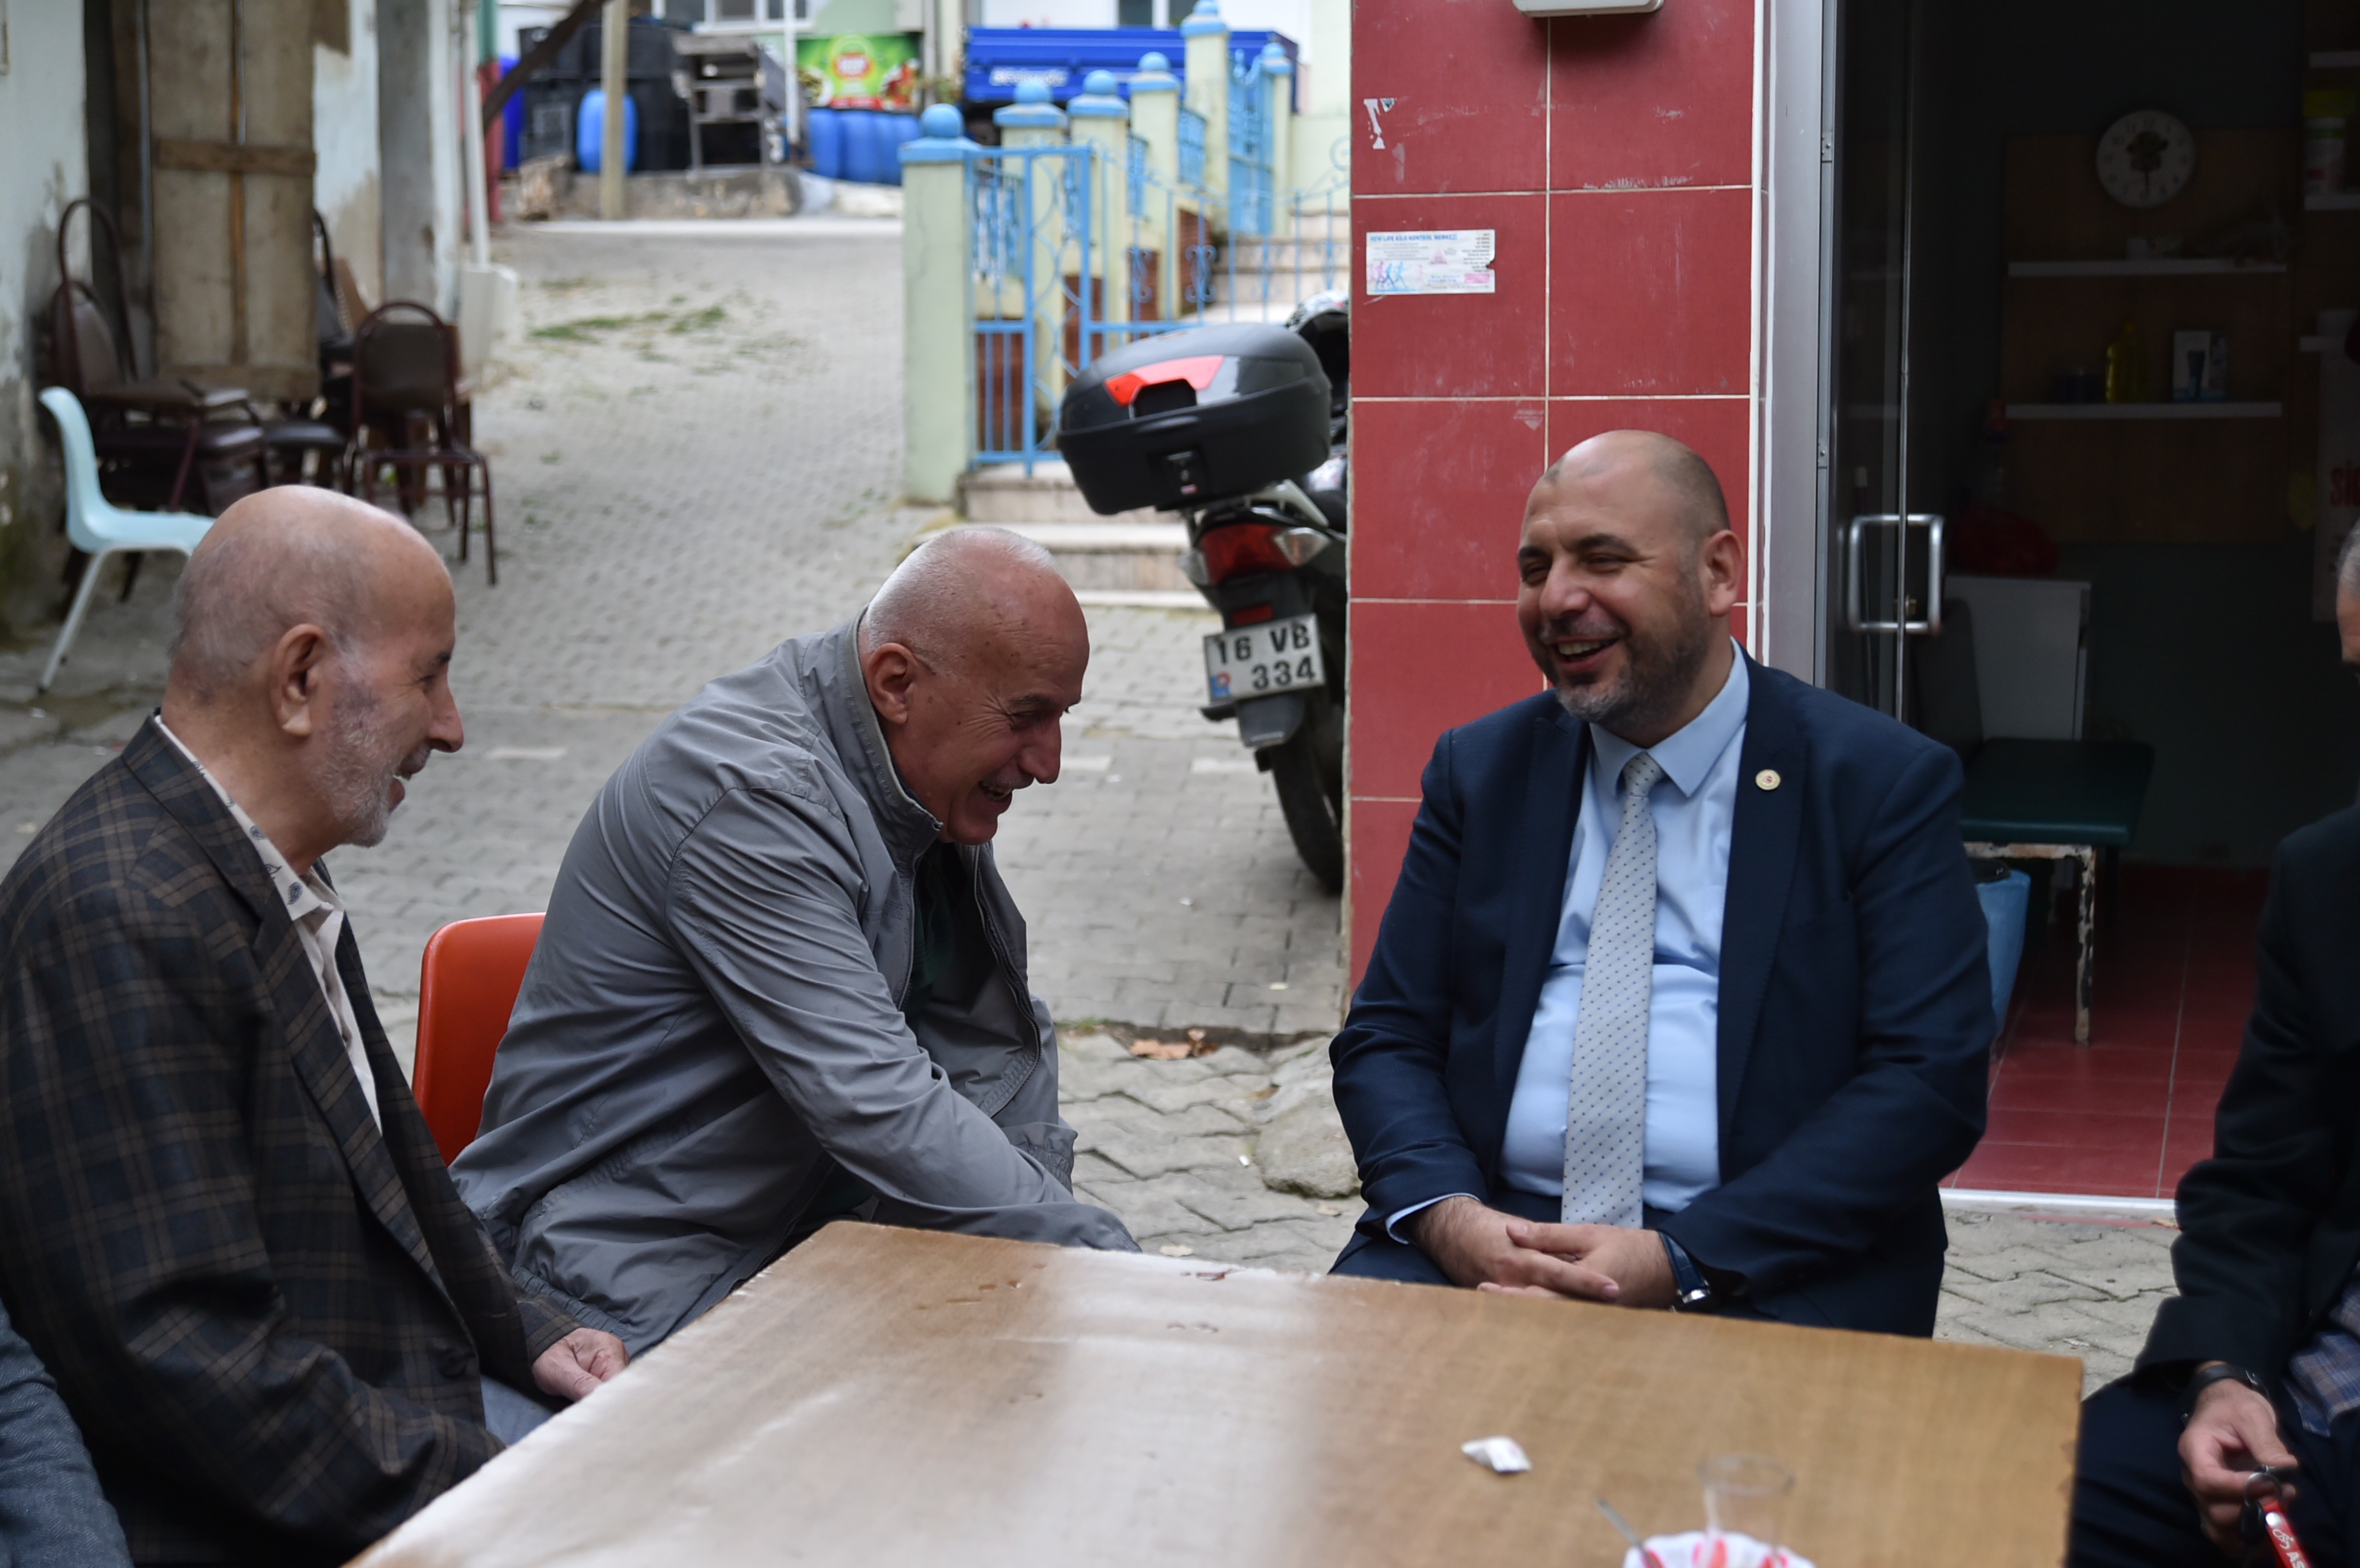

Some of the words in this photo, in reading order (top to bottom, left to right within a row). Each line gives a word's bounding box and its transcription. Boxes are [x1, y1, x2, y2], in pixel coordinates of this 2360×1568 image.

[1216, 636, 1252, 665] 16
[1270, 623, 1310, 653] VB
[1252, 656, 1315, 690] 334
